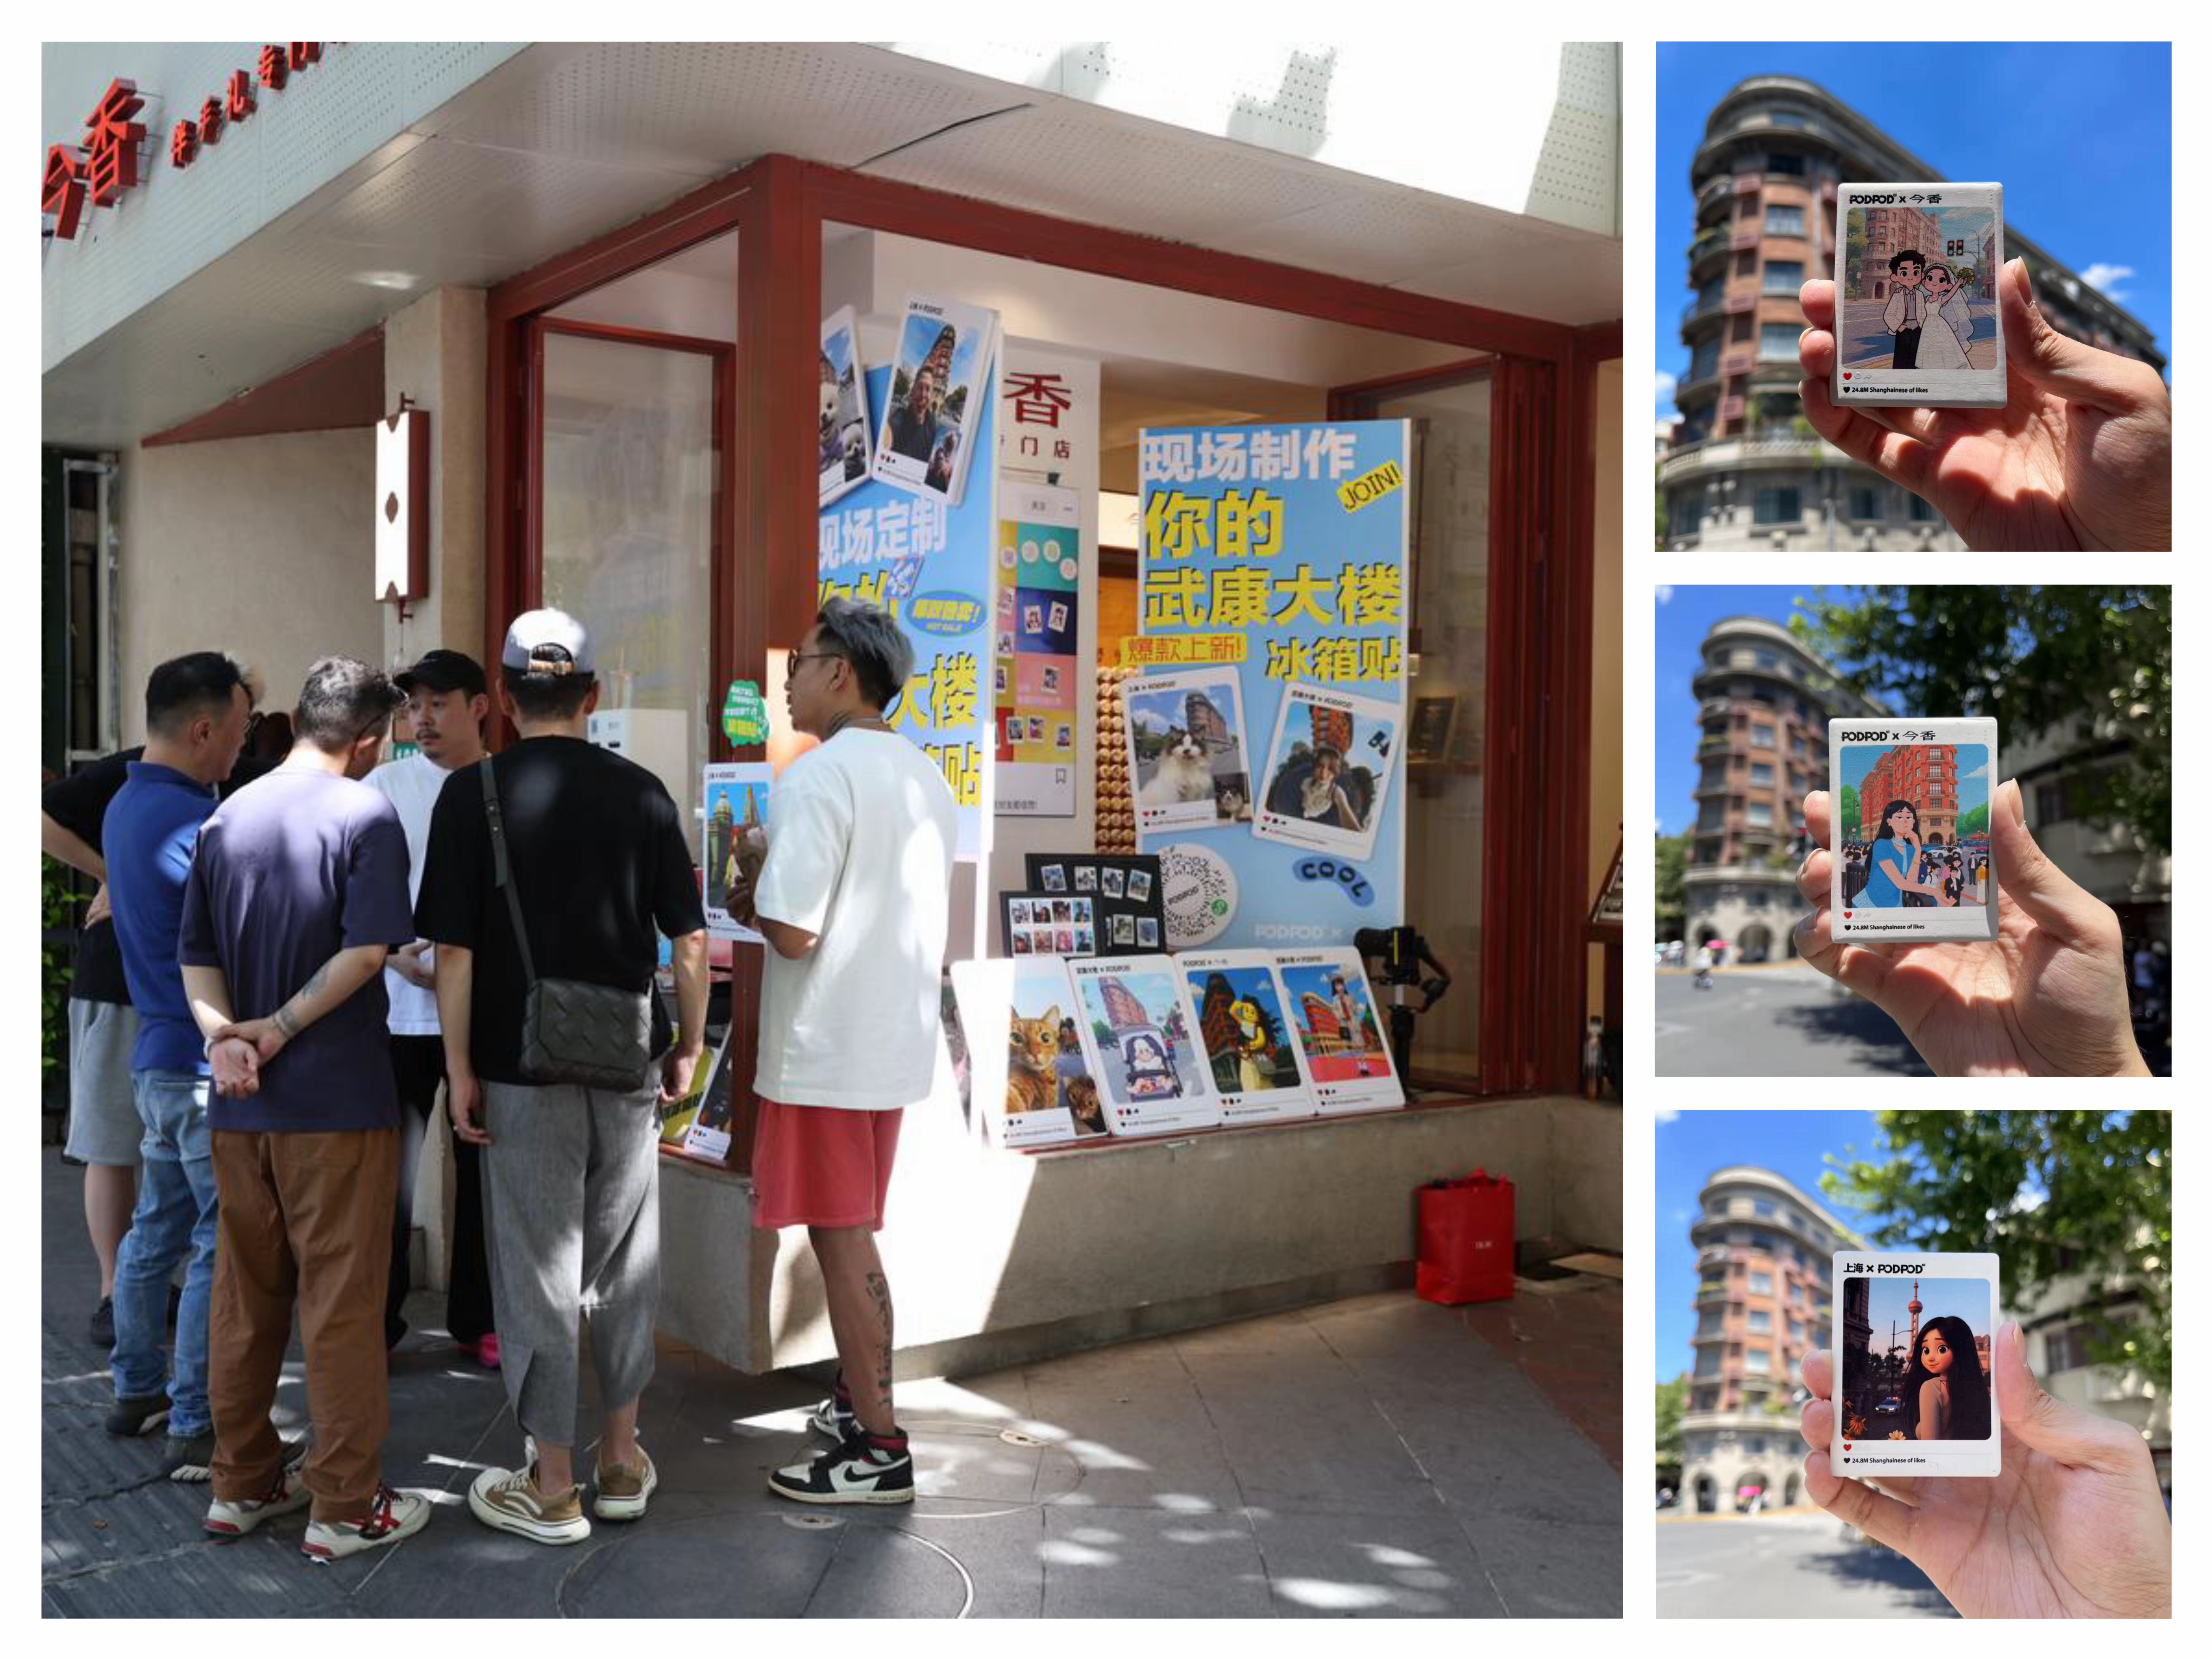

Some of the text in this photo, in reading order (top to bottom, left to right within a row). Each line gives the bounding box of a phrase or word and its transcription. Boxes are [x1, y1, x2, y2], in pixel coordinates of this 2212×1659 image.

[1849, 195, 1894, 204] PODPOD
[1909, 194, 1942, 204] 今香
[1003, 372, 1071, 428] 香
[1142, 428, 1357, 483] 现场制作
[1344, 464, 1401, 510] JOIN!
[1144, 487, 1285, 560] 你的
[1144, 562, 1402, 628] 武康大楼
[1265, 636, 1401, 682] 冰箱贴
[1841, 731, 1887, 741] PODPOD
[1902, 731, 1936, 741] 今香
[1301, 862, 1368, 898] COOL
[1843, 1263, 1864, 1273] 上海
[1877, 1264, 1923, 1274] PODPOD
